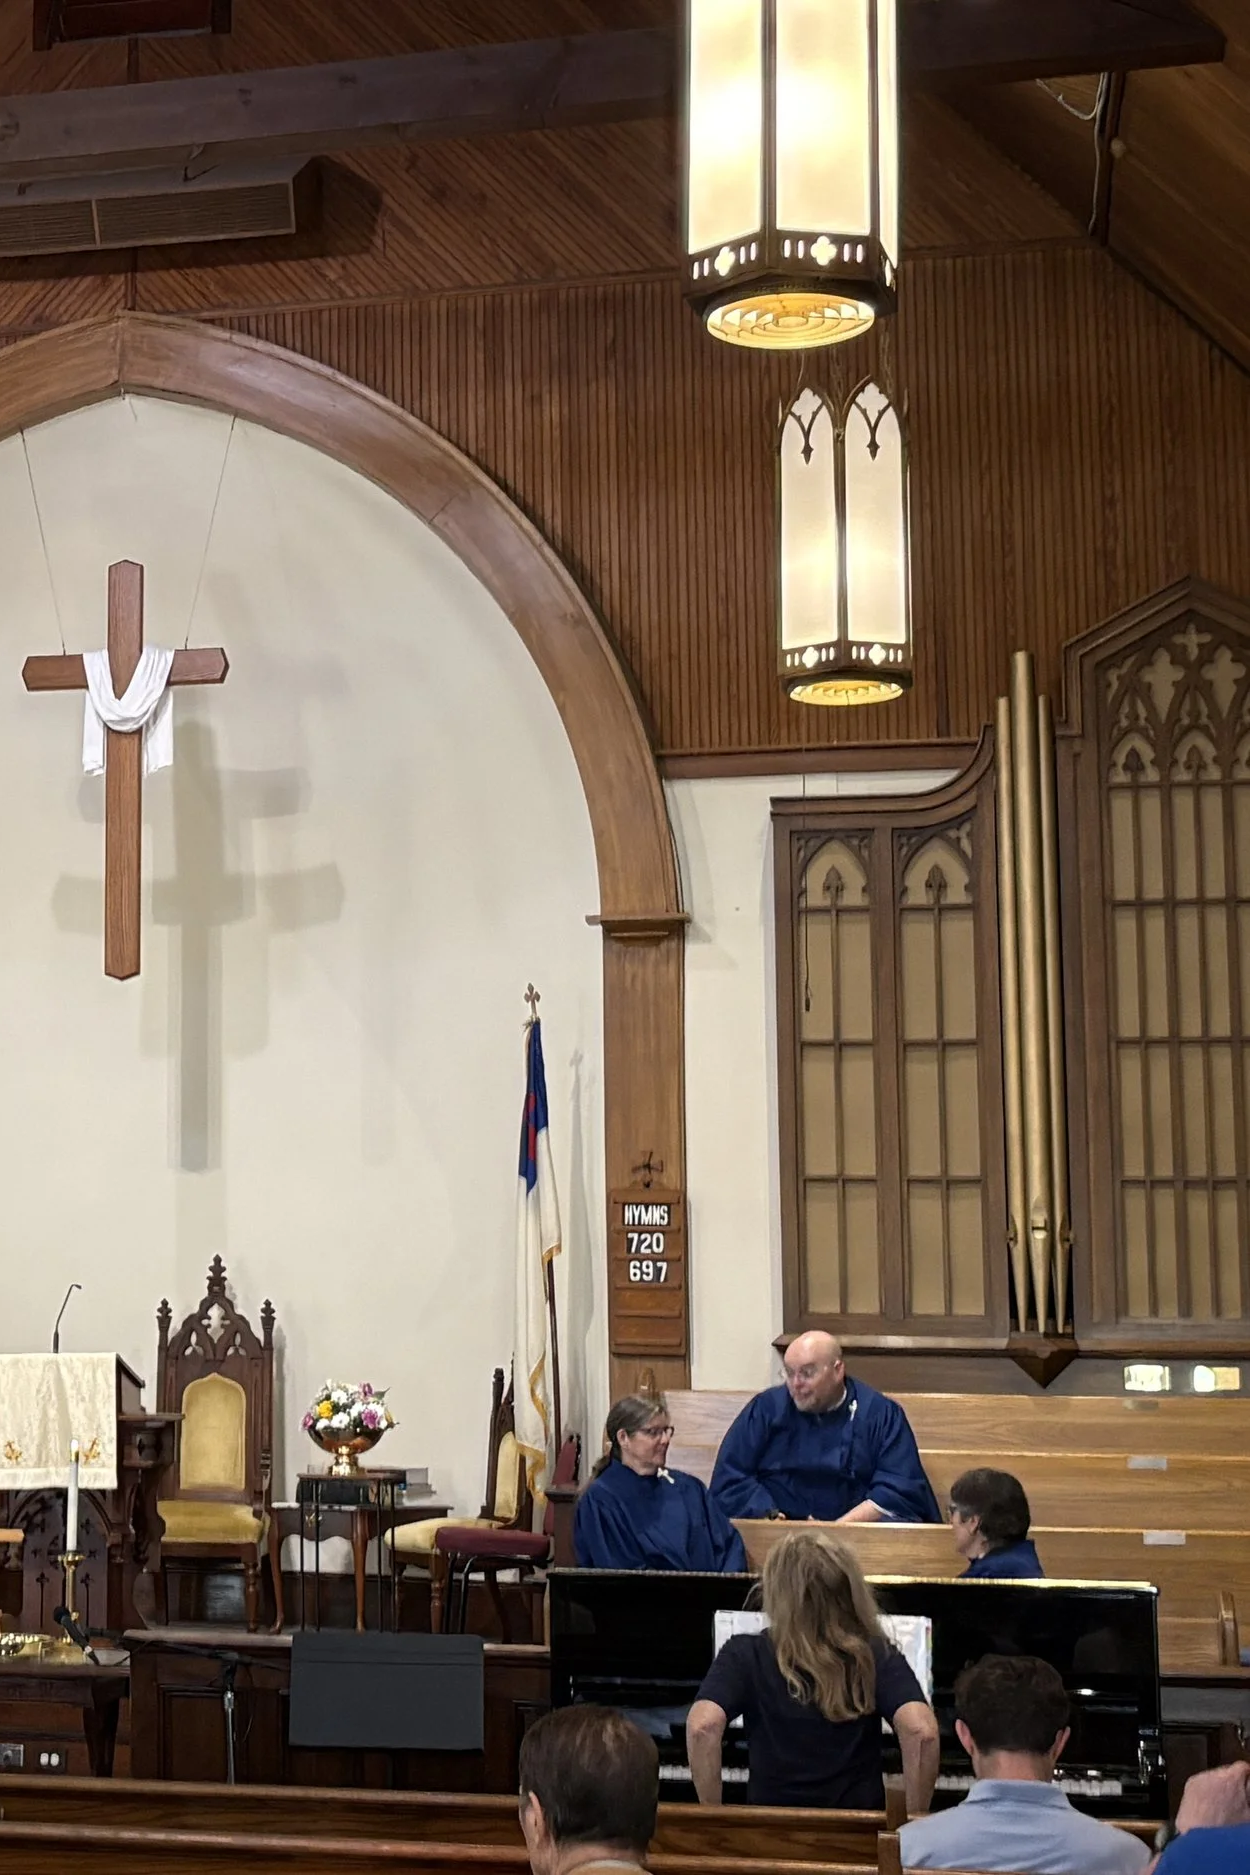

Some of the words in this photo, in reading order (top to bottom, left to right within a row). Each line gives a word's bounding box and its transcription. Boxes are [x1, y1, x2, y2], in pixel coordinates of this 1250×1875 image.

[624, 1204, 669, 1226] HYMNS
[627, 1232, 665, 1254] 720
[629, 1259, 668, 1283] 697
